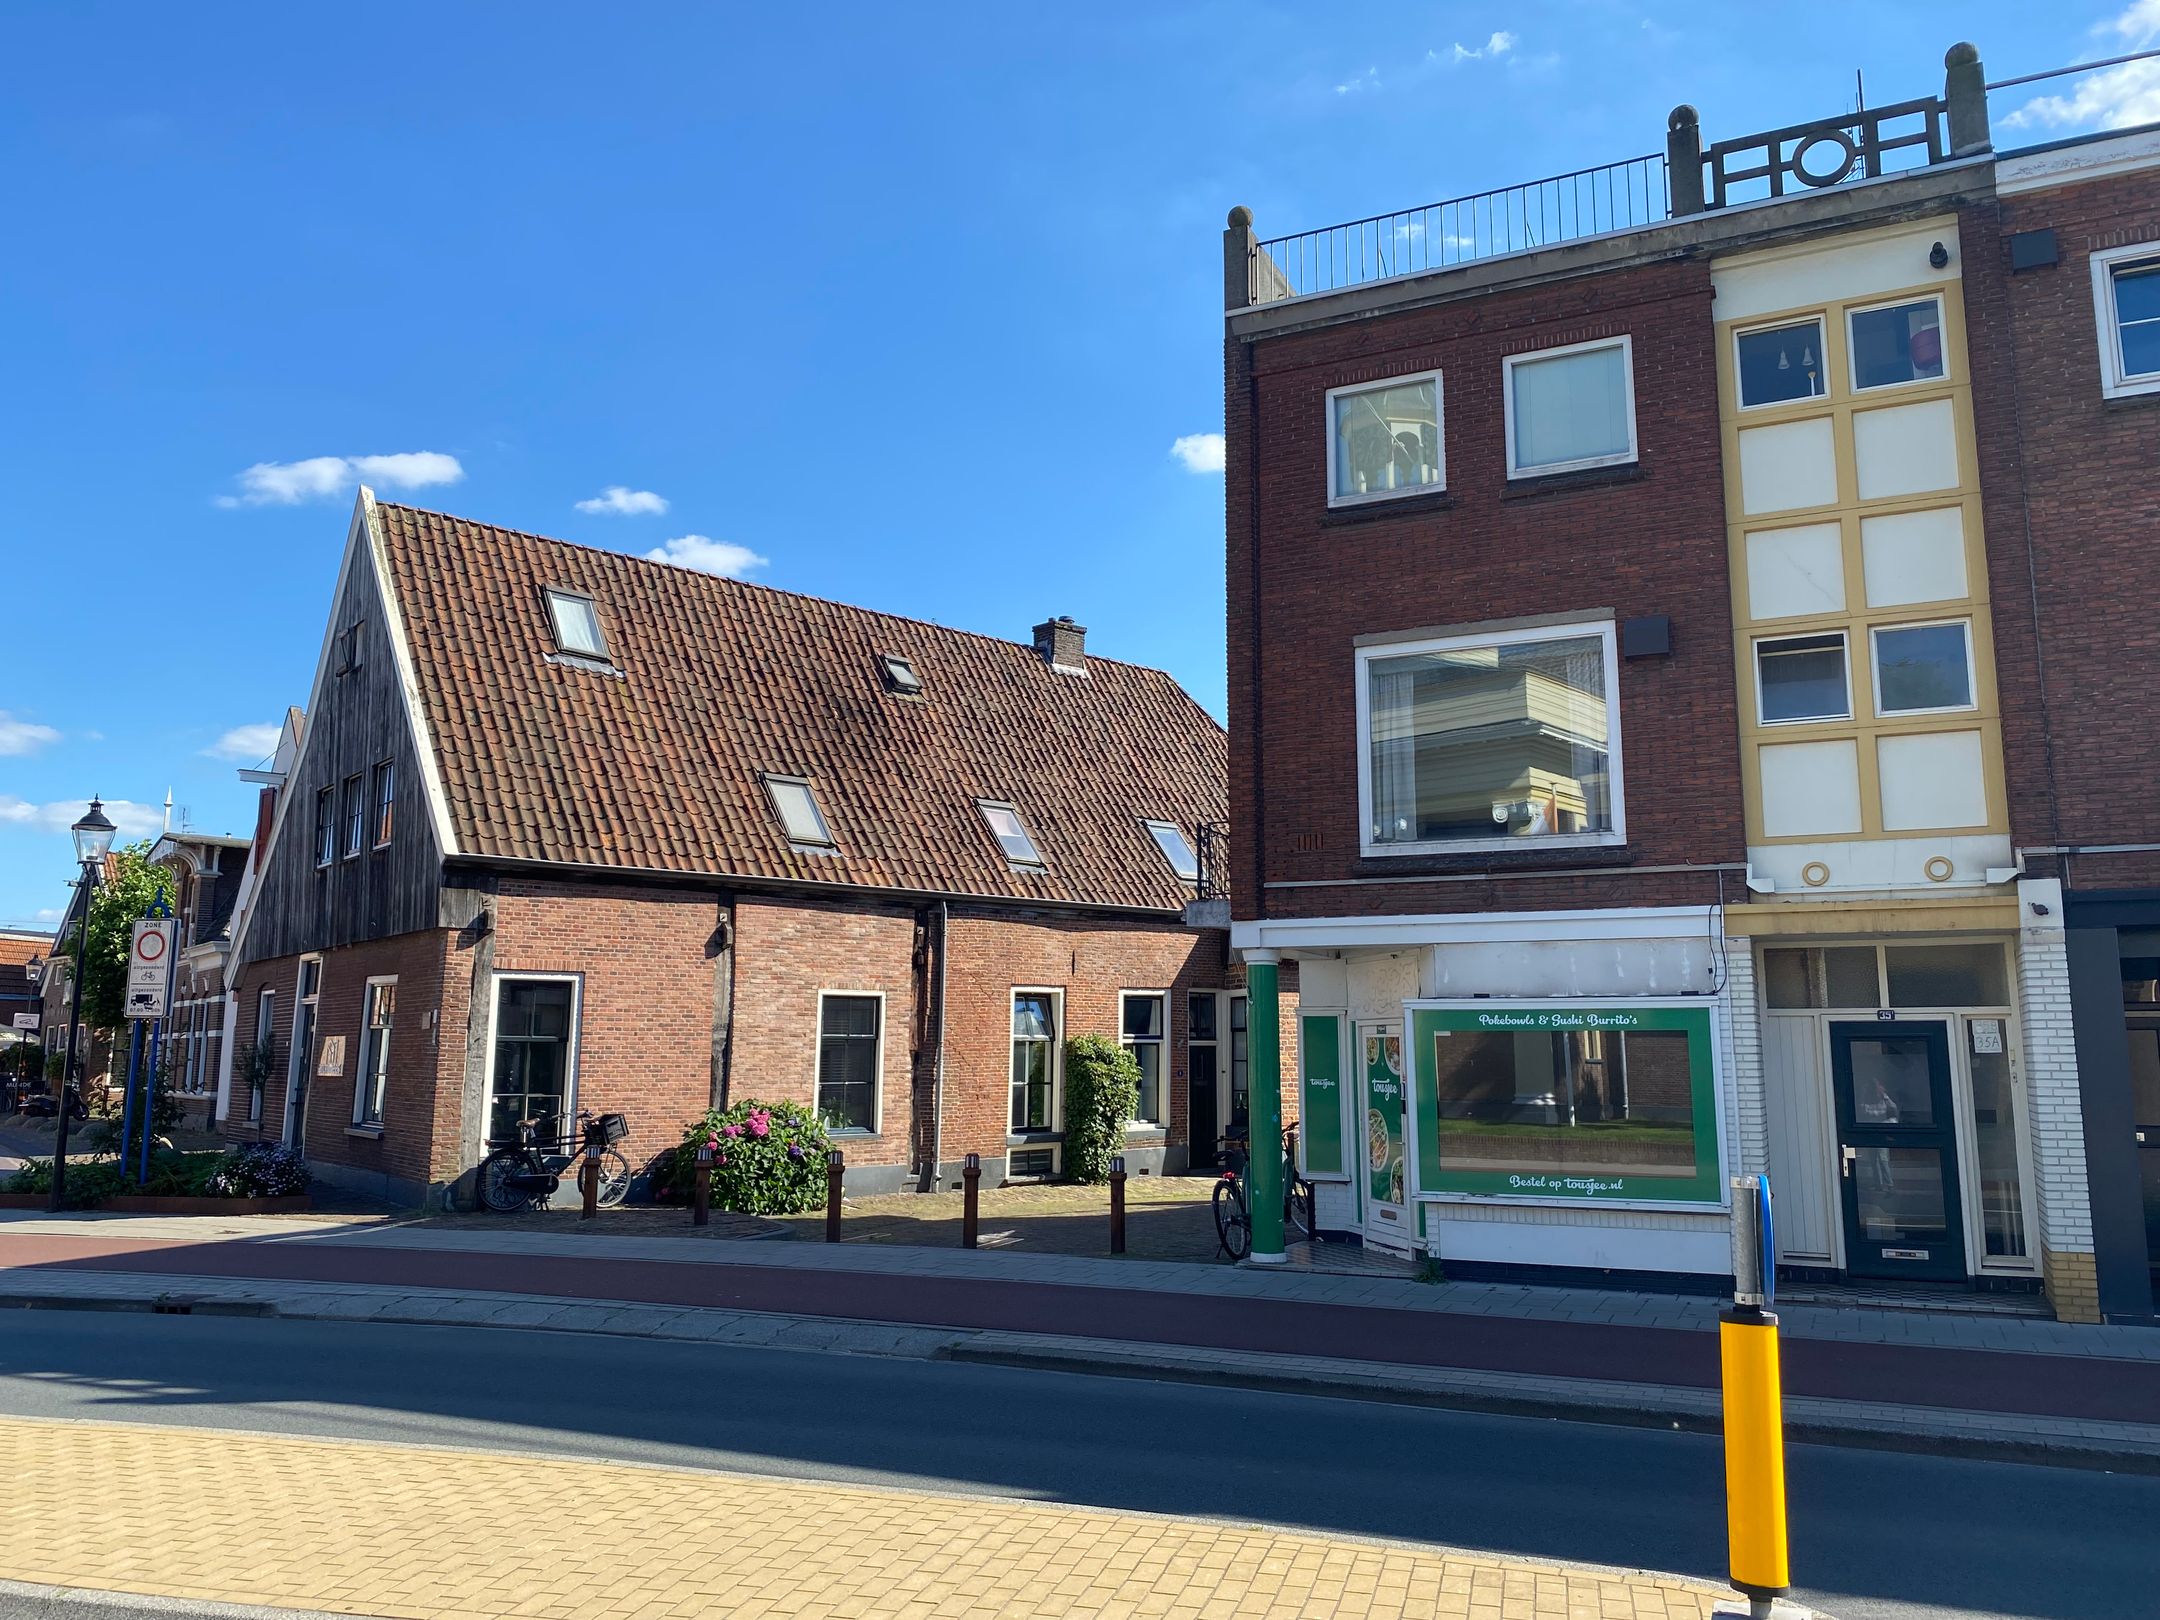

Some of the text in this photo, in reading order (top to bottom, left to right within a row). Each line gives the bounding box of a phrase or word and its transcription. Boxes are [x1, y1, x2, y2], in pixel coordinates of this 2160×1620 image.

[1478, 1013, 1638, 1027] Pokebowls & Sushi Burrito's
[1509, 1175, 1624, 1195] Bestel op tousjee.nl
